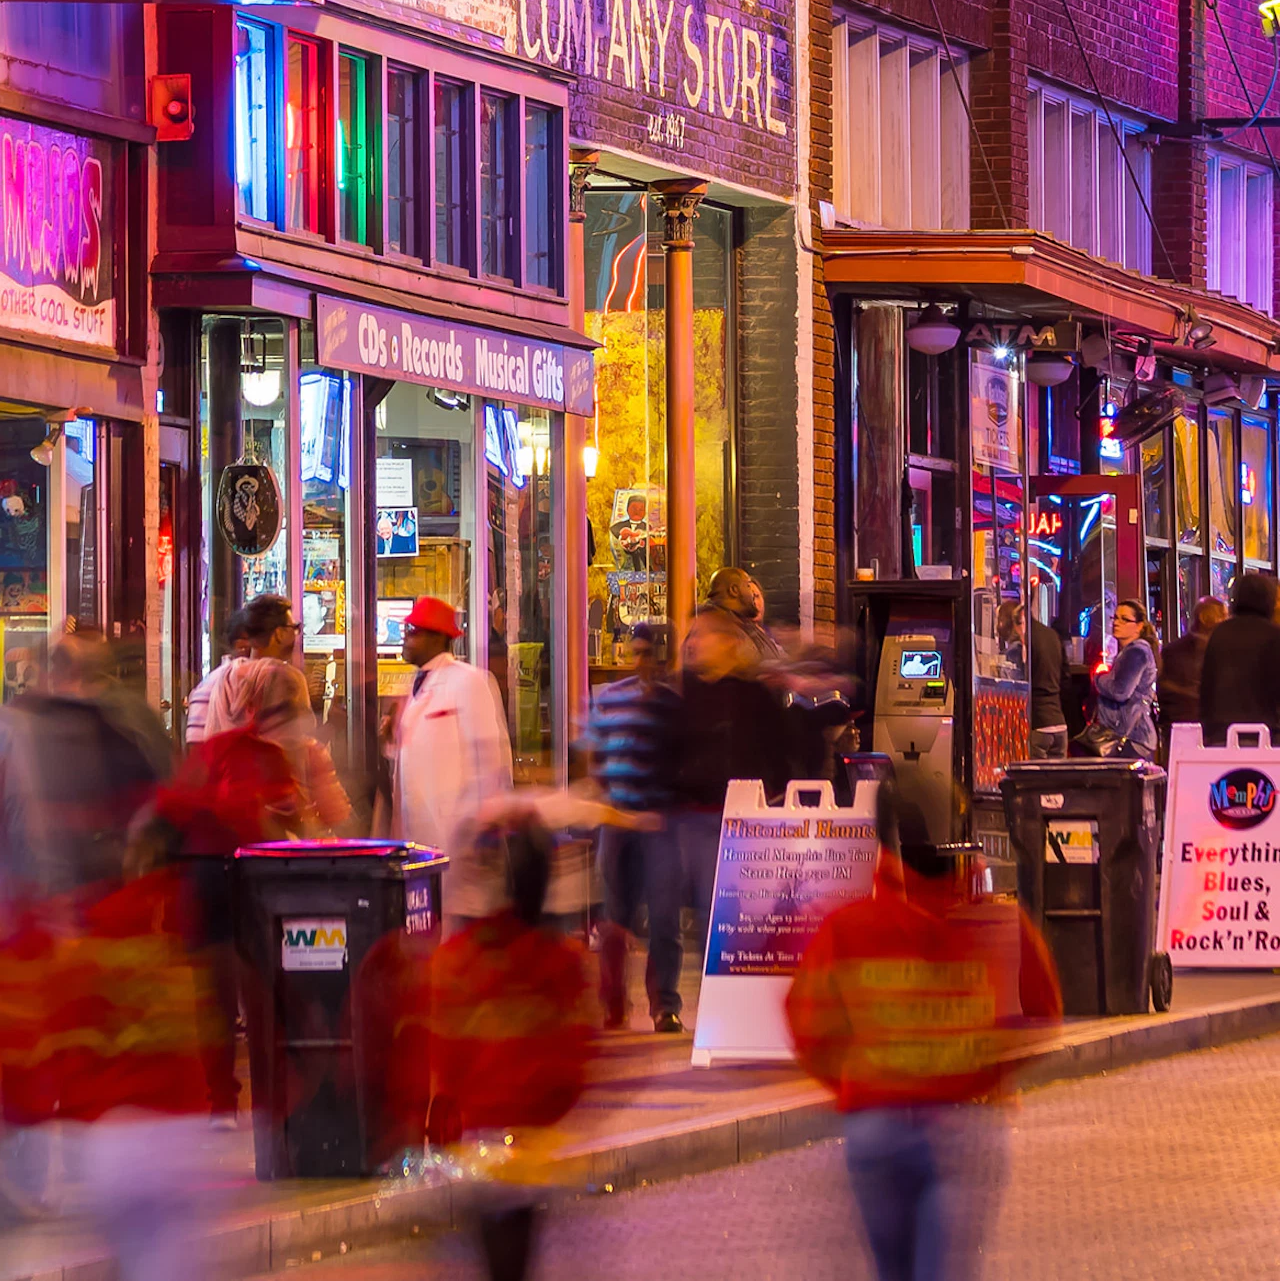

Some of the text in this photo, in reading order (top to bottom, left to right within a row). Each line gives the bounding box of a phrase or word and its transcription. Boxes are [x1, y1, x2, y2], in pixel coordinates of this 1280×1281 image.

[683, 3, 787, 136] STORE
[2, 132, 103, 301] MOJOS
[1, 288, 36, 318] OTHER
[40, 298, 69, 327] COOL
[73, 305, 106, 336] STUFF
[965, 323, 1057, 347] ATM
[358, 311, 388, 368] CDs
[401, 321, 464, 383] Records
[475, 337, 529, 396] Musical
[532, 346, 564, 403] Gifts
[1209, 778, 1280, 811] Memphis
[724, 818, 878, 839] Historical Haunts
[723, 847, 770, 863] Haunted
[772, 848, 823, 866] Memphis
[832, 867, 853, 880] PM
[1203, 871, 1271, 894] Blues,
[1201, 900, 1270, 922] Soul &
[286, 928, 346, 947] WM
